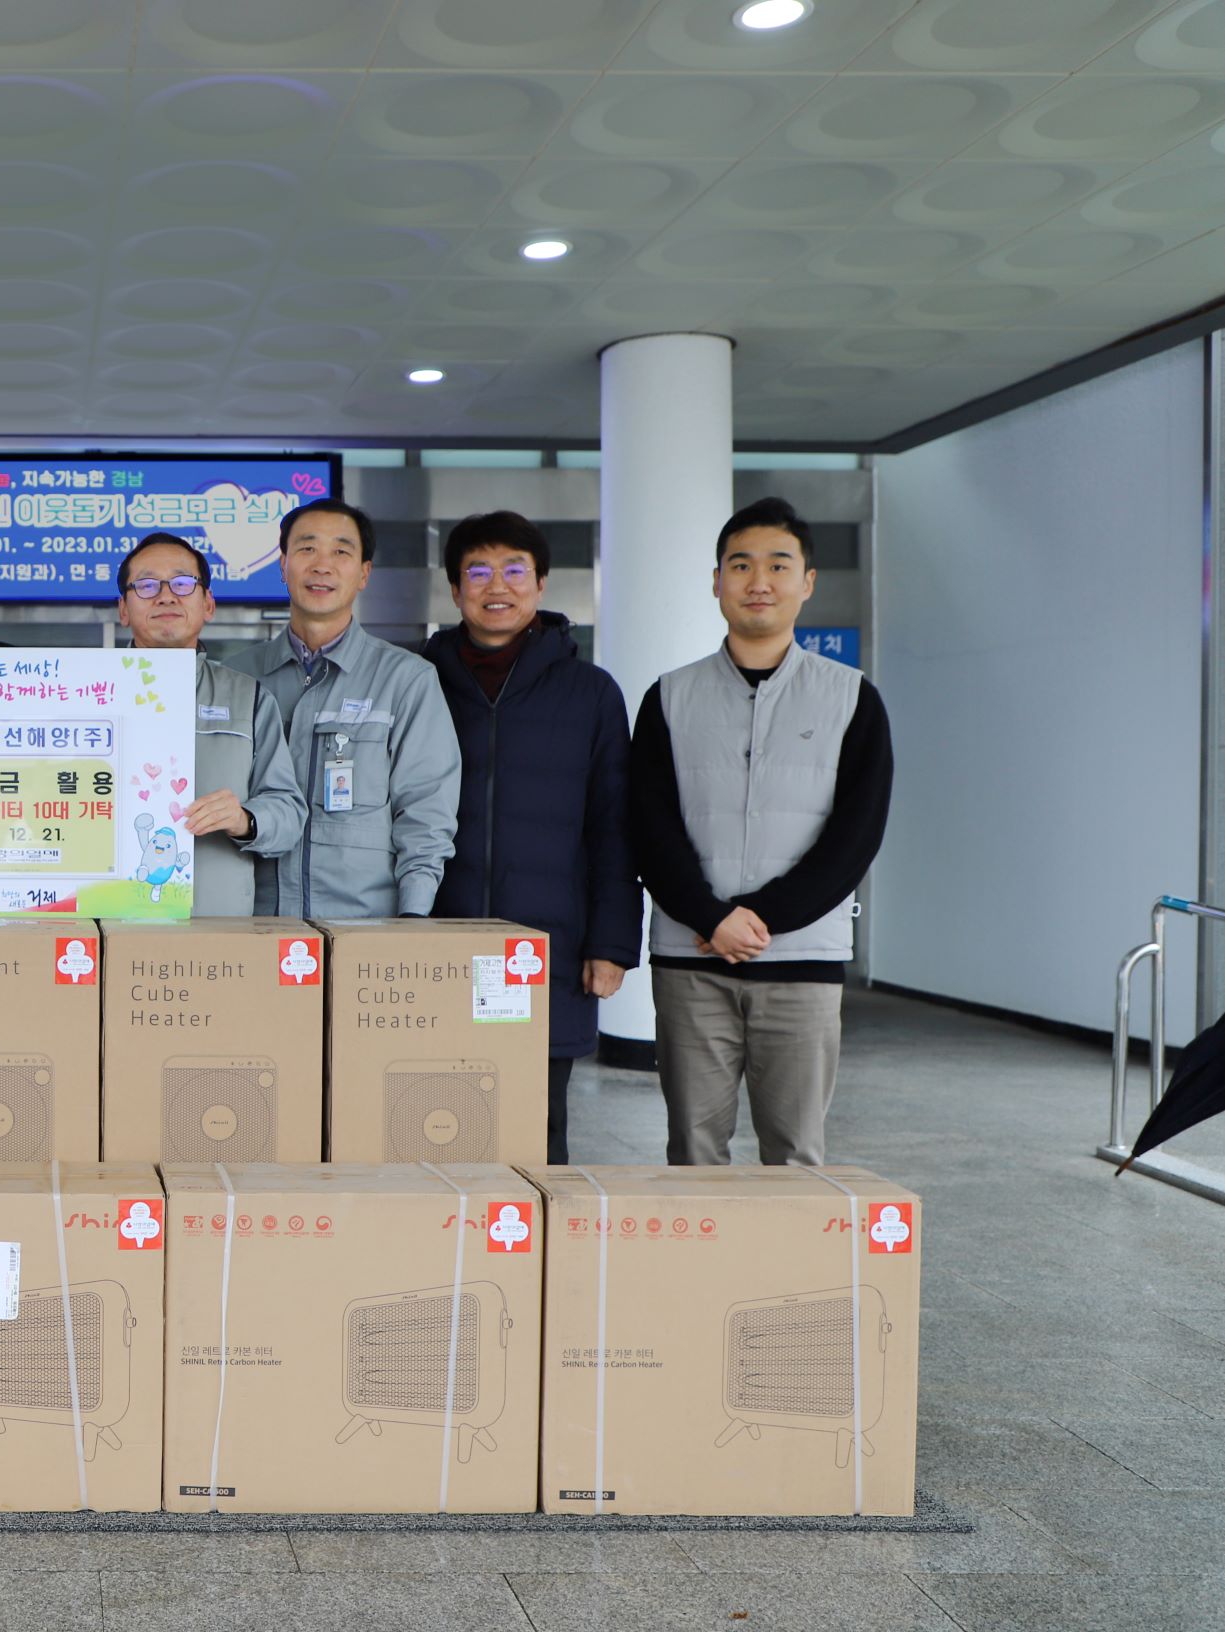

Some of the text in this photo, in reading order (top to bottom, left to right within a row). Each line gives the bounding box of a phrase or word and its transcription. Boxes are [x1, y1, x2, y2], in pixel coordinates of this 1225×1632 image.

[22, 470, 105, 488] 지속가능한
[112, 470, 144, 487] 경남
[14, 494, 125, 528] 이웃돕기
[127, 494, 237, 528] 성금모금
[14, 658, 60, 678] 세상!
[75, 681, 115, 705] 기쁨!
[32, 800, 70, 820] 10대
[77, 800, 114, 820] 기탁
[7, 827, 33, 841] 12.
[41, 827, 66, 841] 21.
[27, 888, 57, 908] 거제
[132, 960, 245, 981] Highlight
[358, 962, 470, 982] Highlight
[131, 985, 190, 1002] Cube
[357, 987, 416, 1004] Cube
[131, 1010, 212, 1027] Heater
[357, 1012, 438, 1029] Heater
[181, 1346, 200, 1356] 신일
[233, 1346, 251, 1357] 카본
[254, 1346, 273, 1357] 히터
[562, 1348, 580, 1358] 신일
[614, 1348, 632, 1359] 카본
[230, 1358, 256, 1366] Carbon
[561, 1360, 664, 1369] SHINIL Reo Carbon Heater
